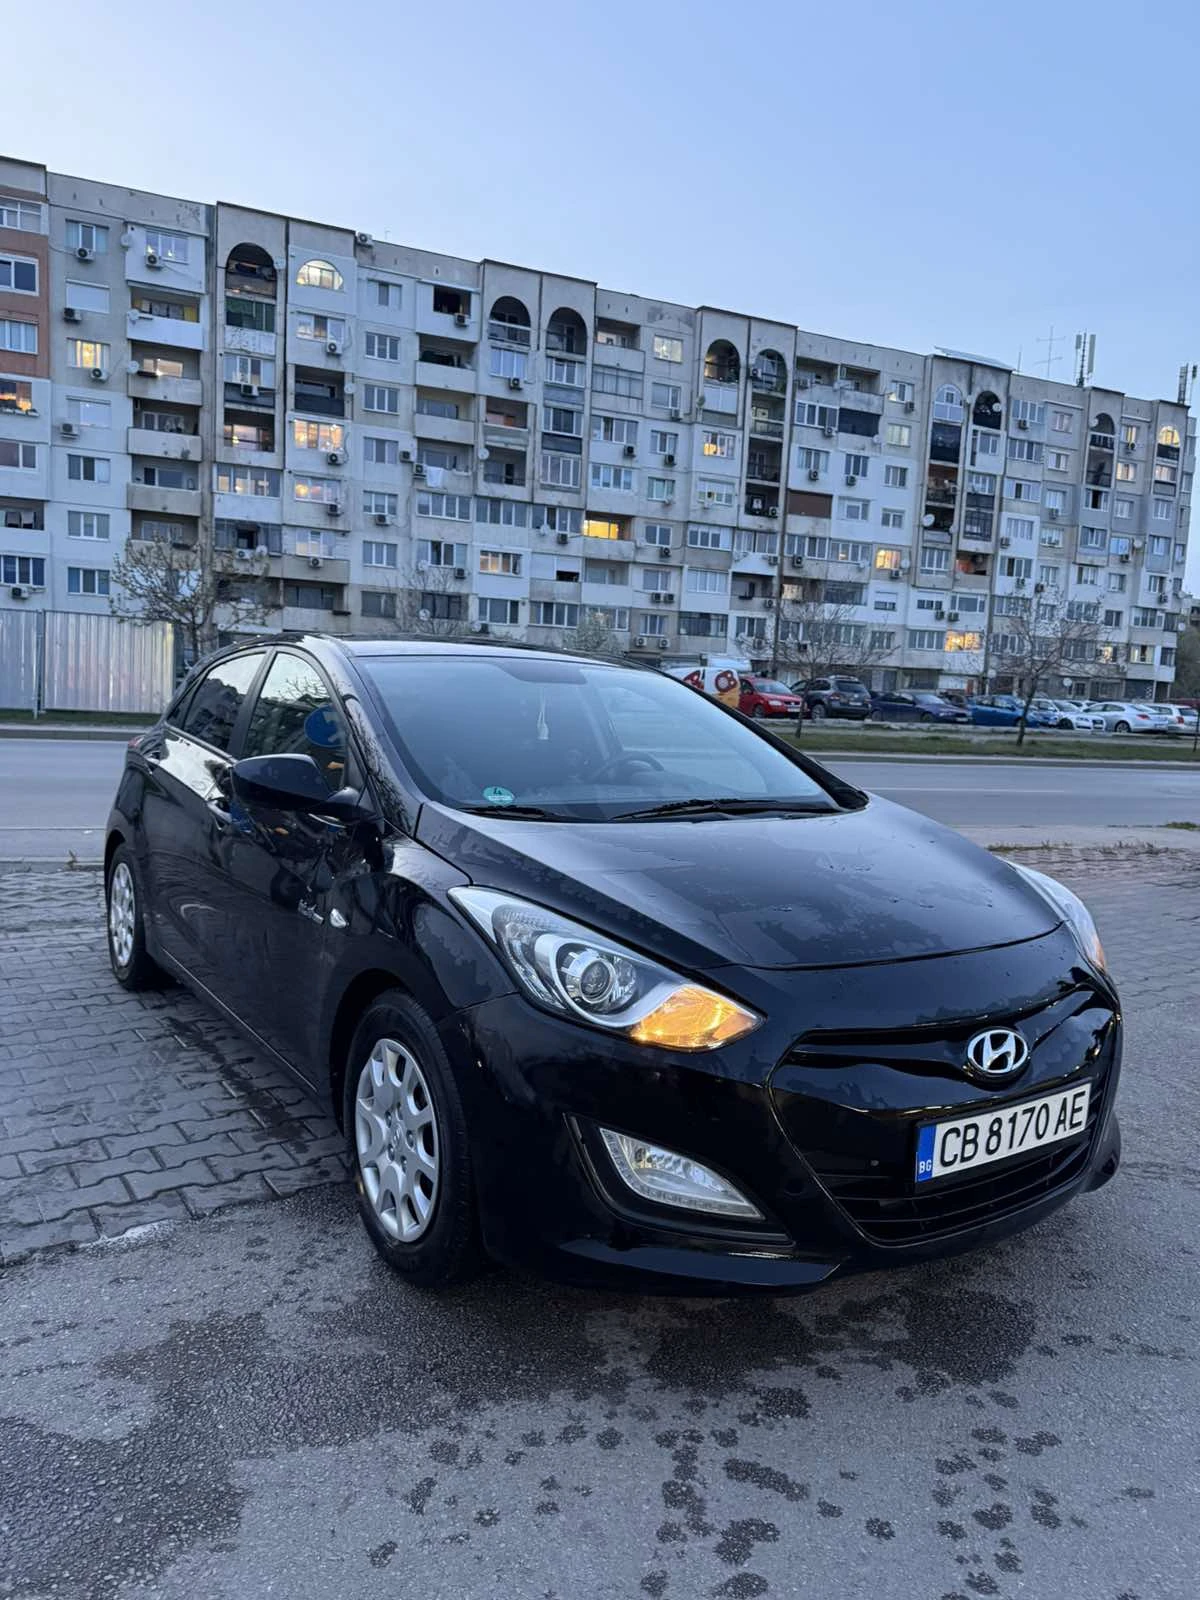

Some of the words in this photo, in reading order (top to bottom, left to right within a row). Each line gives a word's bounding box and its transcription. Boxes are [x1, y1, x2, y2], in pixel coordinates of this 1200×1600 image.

[940, 1122, 979, 1167] CB
[986, 1103, 1049, 1155] 8170
[1054, 1090, 1086, 1135] AE
[919, 1159, 932, 1173] BG
